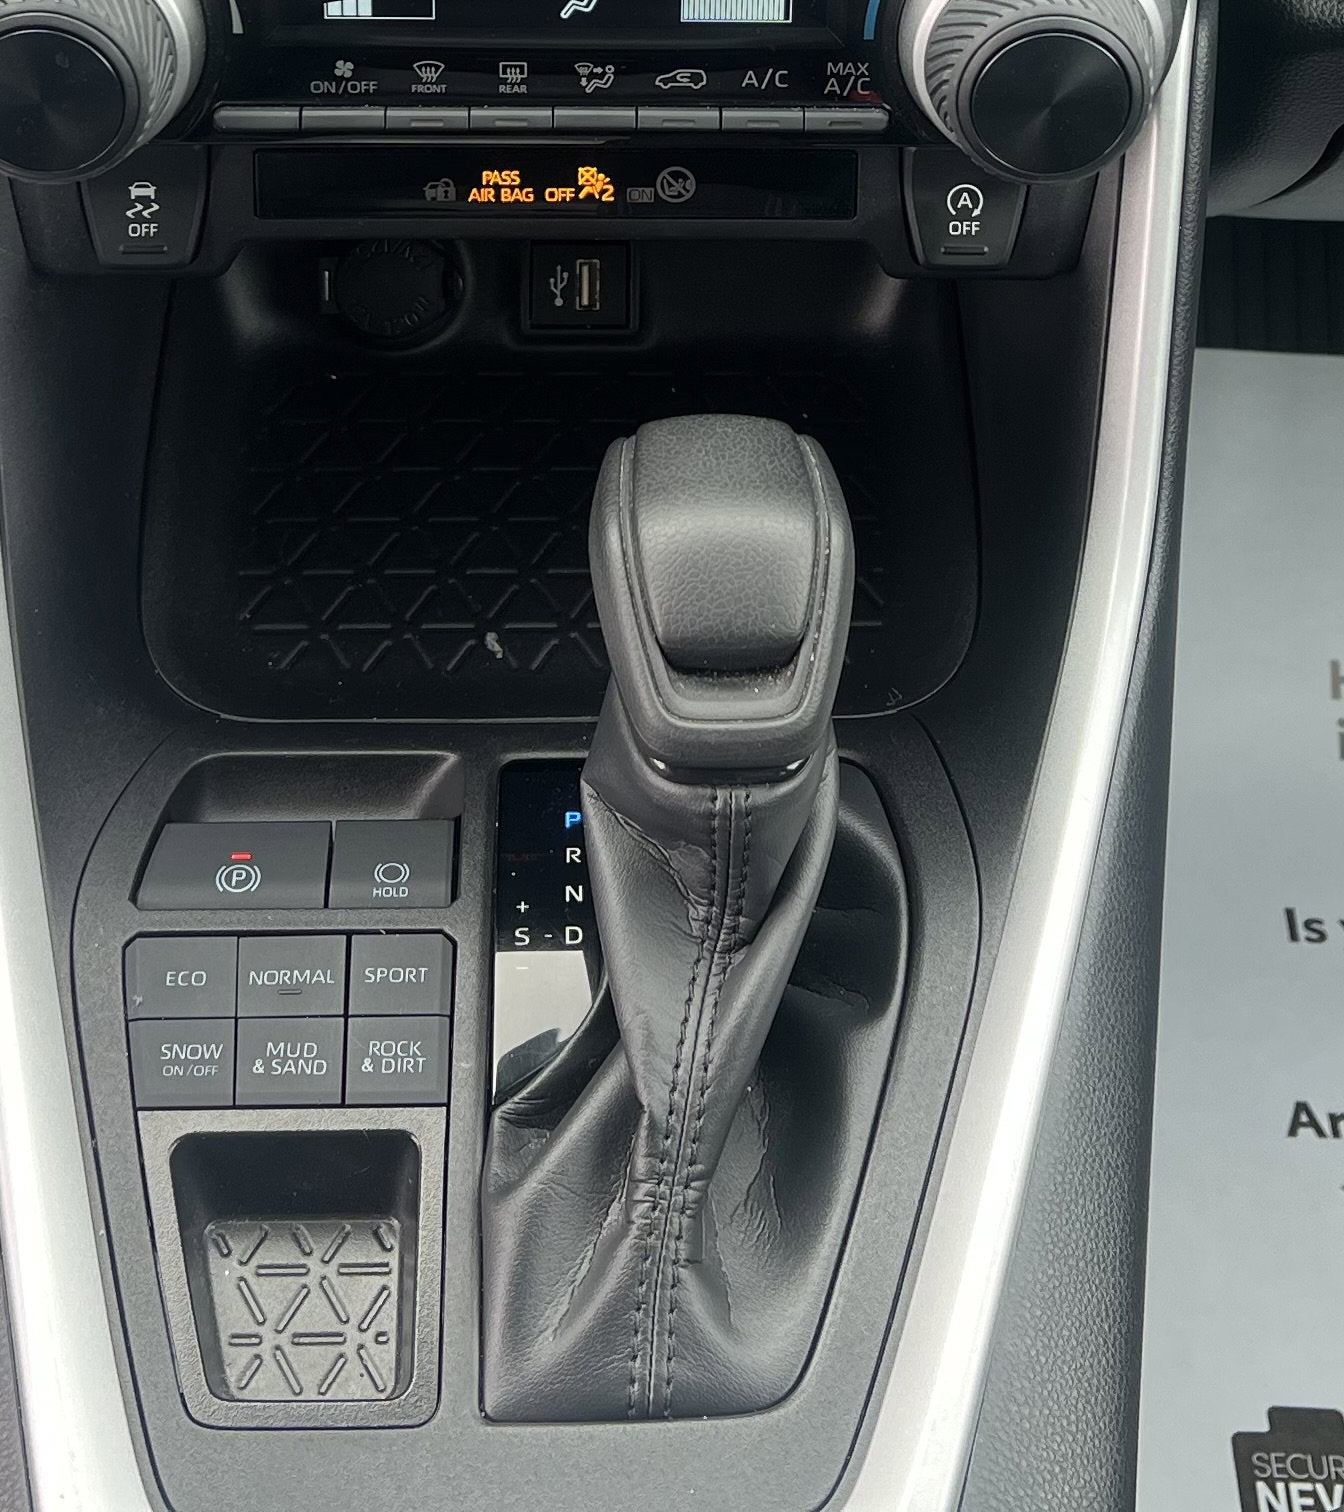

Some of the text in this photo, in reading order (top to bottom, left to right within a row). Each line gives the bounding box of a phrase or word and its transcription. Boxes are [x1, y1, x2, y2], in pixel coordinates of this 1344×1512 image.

[826, 62, 869, 76] MAX
[741, 68, 789, 90] A/C
[824, 76, 871, 96] A/C
[411, 84, 447, 94] FRONT
[498, 84, 528, 94] REAR
[482, 170, 521, 186] PASS
[468, 187, 496, 202] AIR
[501, 187, 535, 203] BAG
[544, 188, 576, 203] OFF
[128, 223, 159, 238] OFF
[949, 220, 980, 236] OFF
[565, 811, 581, 829] P
[565, 847, 581, 864] R
[372, 886, 409, 898] HOLD
[565, 885, 583, 903] N
[1285, 908, 1327, 943] Is
[514, 926, 583, 946] S D
[165, 969, 207, 986] ECO
[248, 968, 336, 985] NORMAL
[364, 966, 428, 983] SPORT
[160, 1043, 223, 1061] SNOW
[266, 1042, 318, 1058] MUD
[368, 1040, 422, 1056] ROCK
[253, 1058, 328, 1076] & SAND
[361, 1057, 426, 1074] & DIRT
